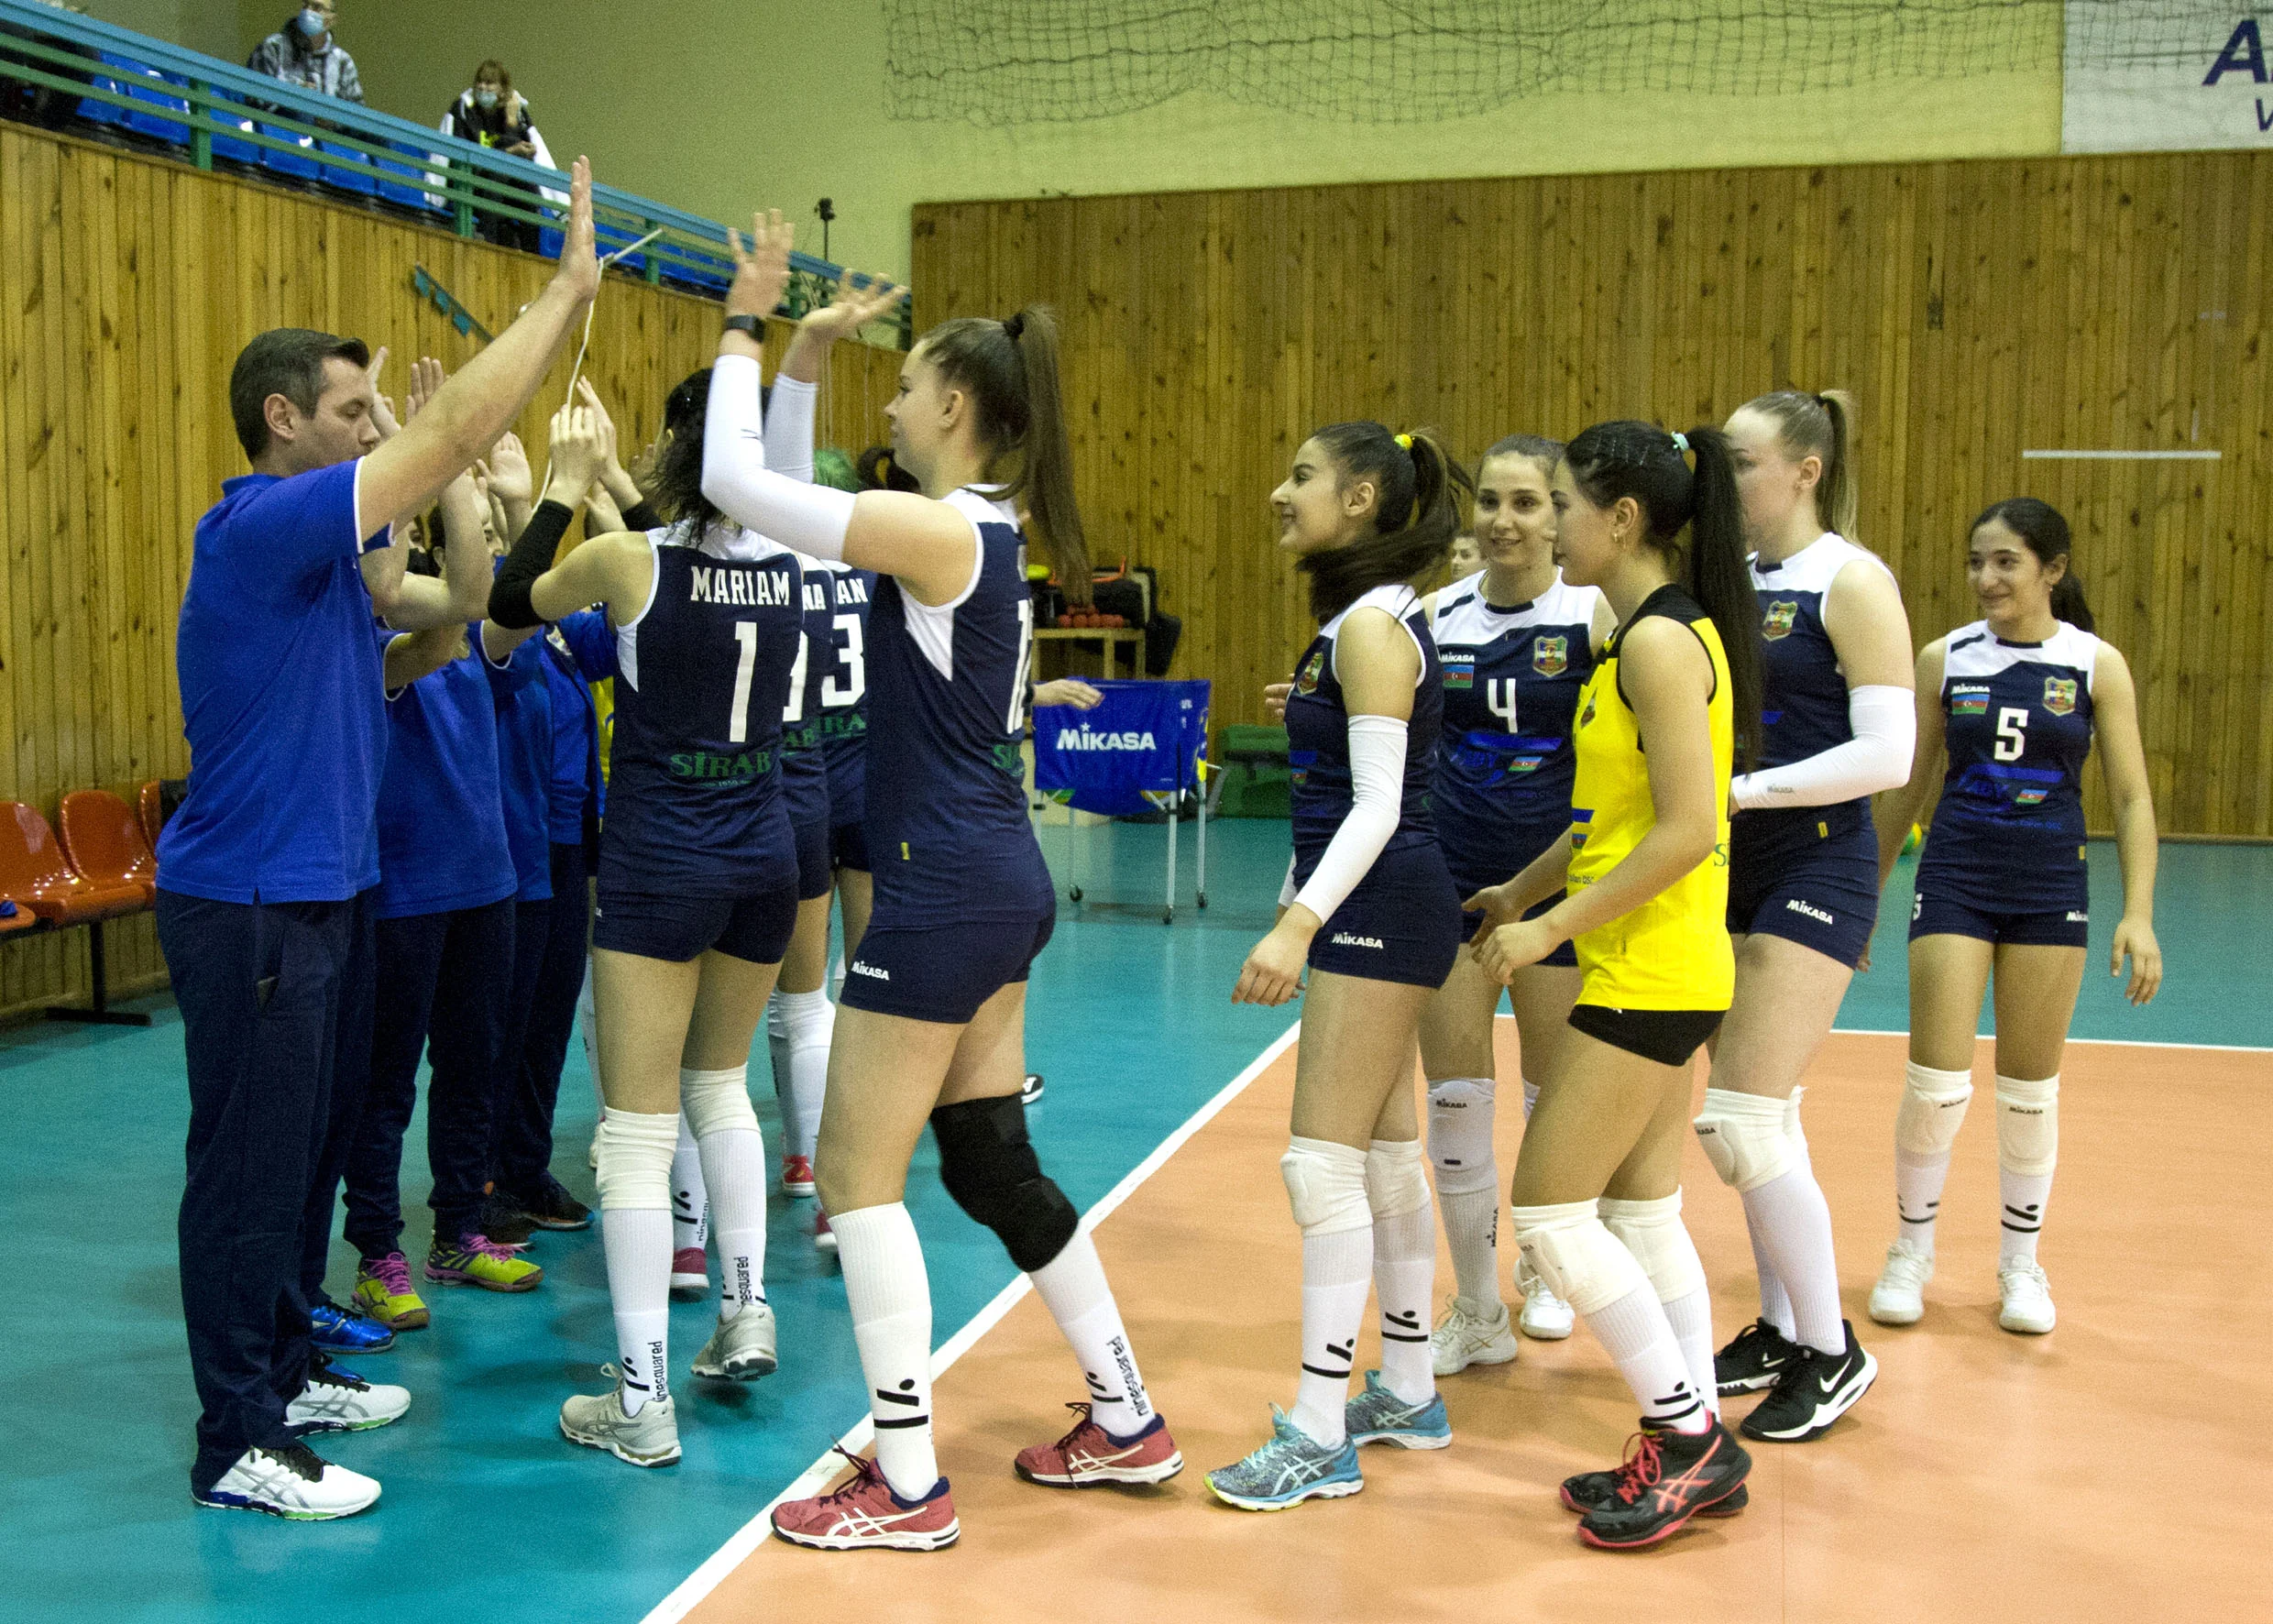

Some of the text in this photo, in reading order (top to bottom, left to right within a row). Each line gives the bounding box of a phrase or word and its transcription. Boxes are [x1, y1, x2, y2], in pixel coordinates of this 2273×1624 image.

[690, 565, 790, 606] MARIAM
[802, 583, 827, 610] NA
[836, 577, 869, 605] AN
[821, 613, 865, 707] 3
[729, 620, 758, 743] 1
[1488, 678, 1518, 733] 4
[1057, 722, 1157, 751] MIKASA
[1993, 707, 2029, 762] 5
[1786, 900, 1833, 925] MIKASA
[1332, 931, 1384, 949] MIKASA
[851, 960, 890, 981] MIKASA
[647, 1341, 666, 1401] inesquared
